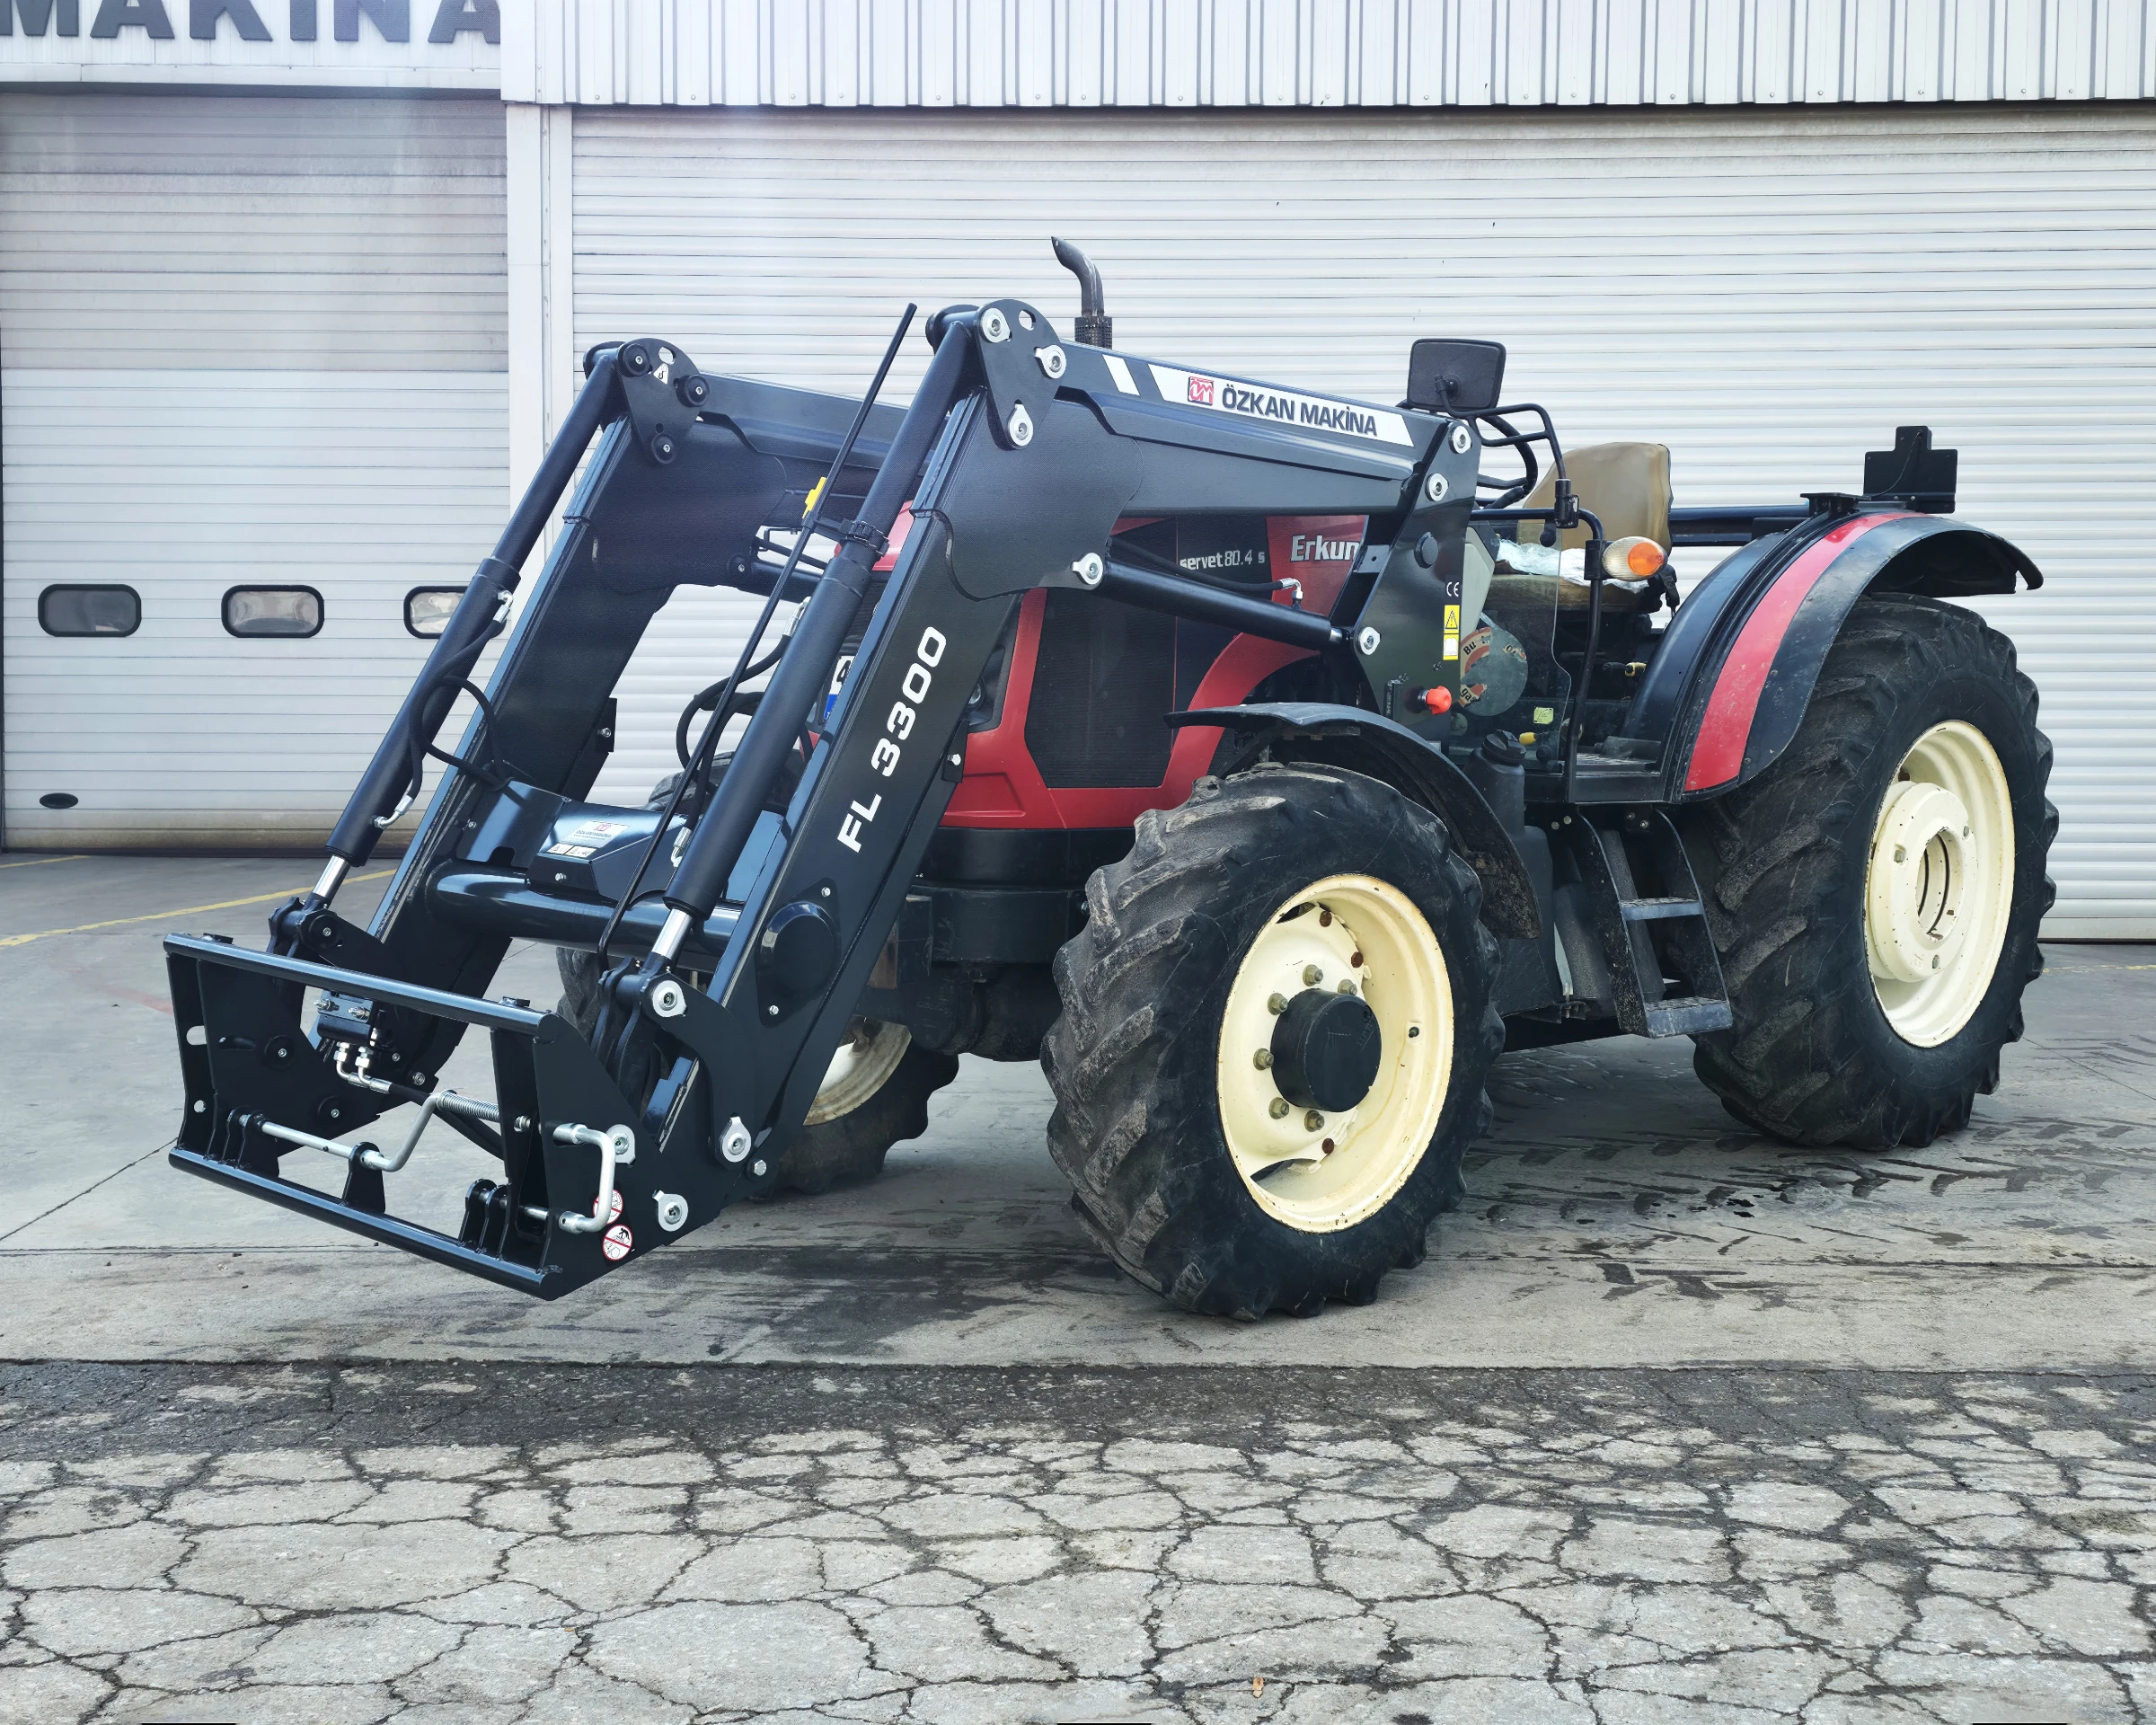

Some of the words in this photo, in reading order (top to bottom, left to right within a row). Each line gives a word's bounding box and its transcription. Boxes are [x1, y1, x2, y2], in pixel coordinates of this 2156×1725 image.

[1222, 384, 1294, 422] ÖZKAN
[1300, 402, 1378, 437] MAKİNA
[836, 793, 882, 853] FL
[870, 626, 947, 777] 3300
